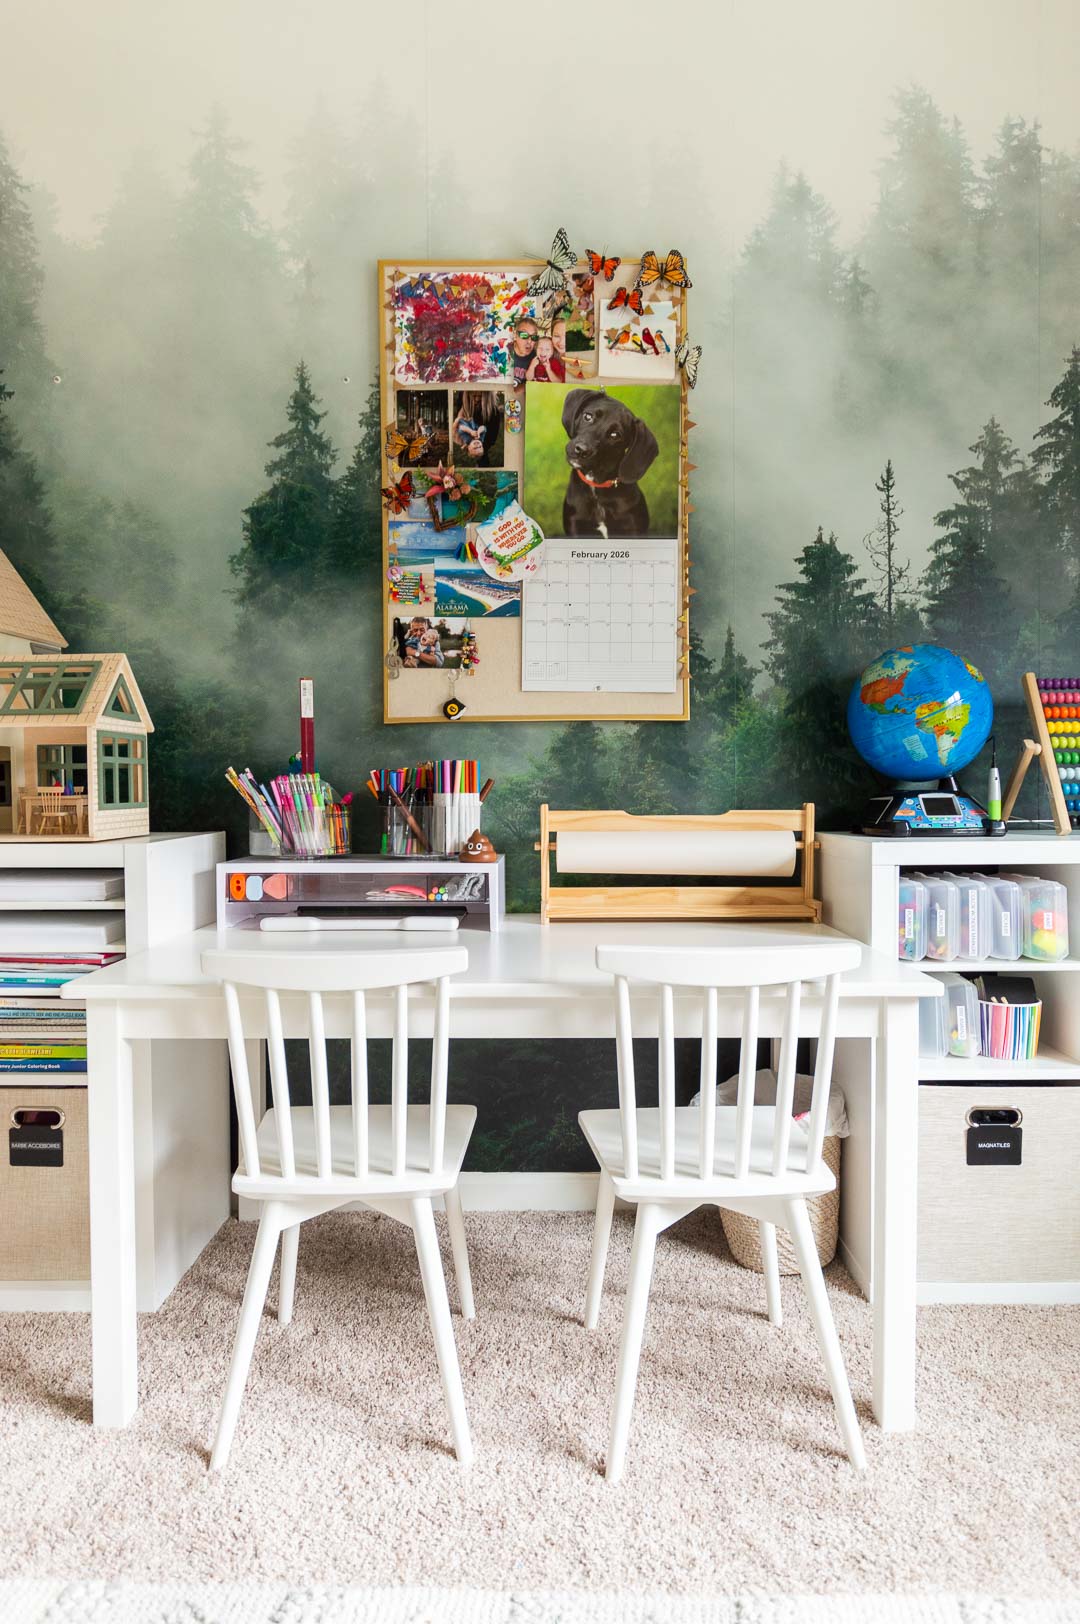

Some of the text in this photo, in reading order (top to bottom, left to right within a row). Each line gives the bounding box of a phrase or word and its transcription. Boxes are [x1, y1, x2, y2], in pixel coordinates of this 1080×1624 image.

[499, 521, 512, 531] GOD
[499, 528, 514, 539] WITH
[514, 520, 524, 530] YOU
[505, 541, 516, 549] YOU
[571, 550, 630, 560] February 2026
[436, 603, 469, 611] ALABAMA
